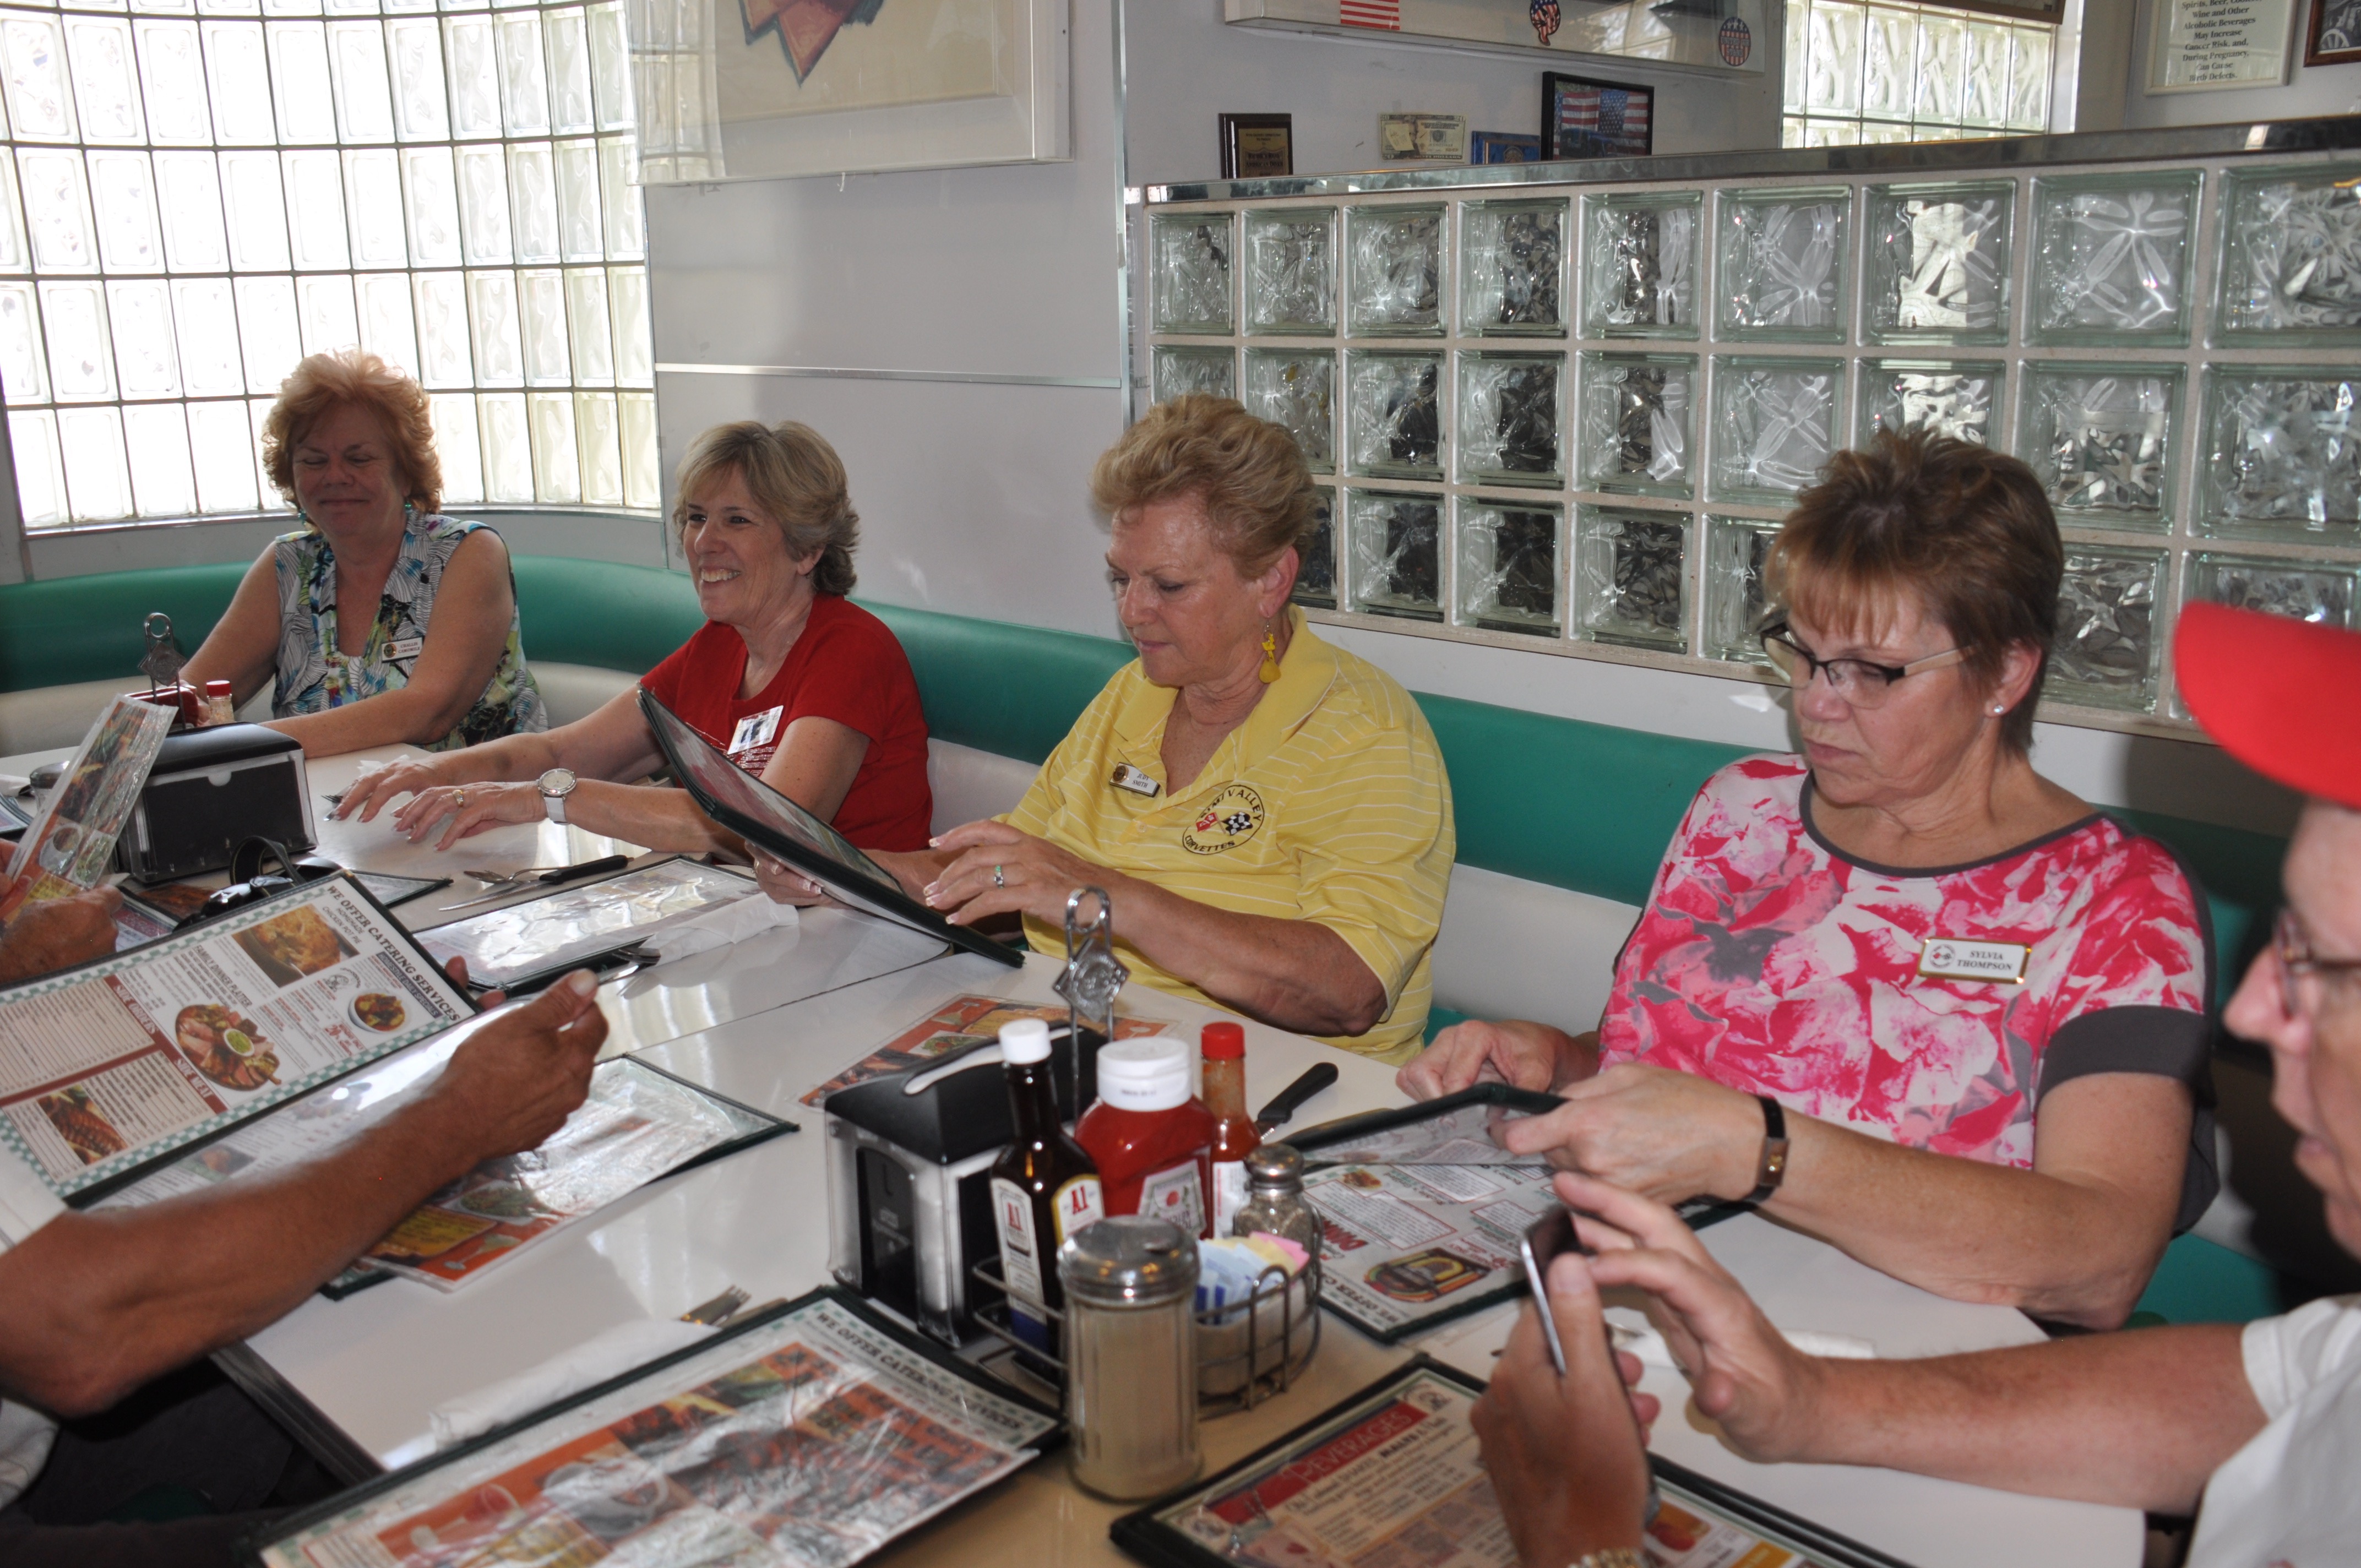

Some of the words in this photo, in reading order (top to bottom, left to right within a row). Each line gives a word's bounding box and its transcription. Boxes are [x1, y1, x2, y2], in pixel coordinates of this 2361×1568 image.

[2184, 20, 2217, 30] Alcoholic
[2219, 18, 2256, 26] Beverages
[2212, 8, 2226, 17] and
[2228, 7, 2249, 15] Other
[2194, 32, 2208, 40] May
[2211, 30, 2242, 38] Increase
[2189, 73, 2207, 81] Birth
[2209, 72, 2237, 80] Defects.
[1132, 780, 1148, 788] SMITH
[1227, 788, 1262, 821] VALLEY
[1185, 835, 1235, 852] CORVETTES
[323, 906, 344, 926] CHICKEN
[342, 925, 355, 937] POT
[351, 934, 362, 944] PIE
[337, 907, 365, 934] HOMEMADE
[328, 885, 344, 900] WE
[340, 898, 372, 928] OFFER
[368, 927, 416, 974] CATERING
[412, 973, 460, 1021] SERVICES
[1957, 960, 2012, 970] THOMPSON
[1970, 950, 2003, 960] SYLVIA
[210, 965, 233, 984] DINNER
[231, 984, 253, 1007] PLATTER
[113, 986, 135, 1003] SIDE
[128, 1003, 157, 1035] ORDERS
[414, 992, 440, 1016] SPECIALS
[173, 1059, 197, 1078] SIDE
[189, 1075, 213, 1098] MEAT
[837, 1326, 882, 1358] OFFER
